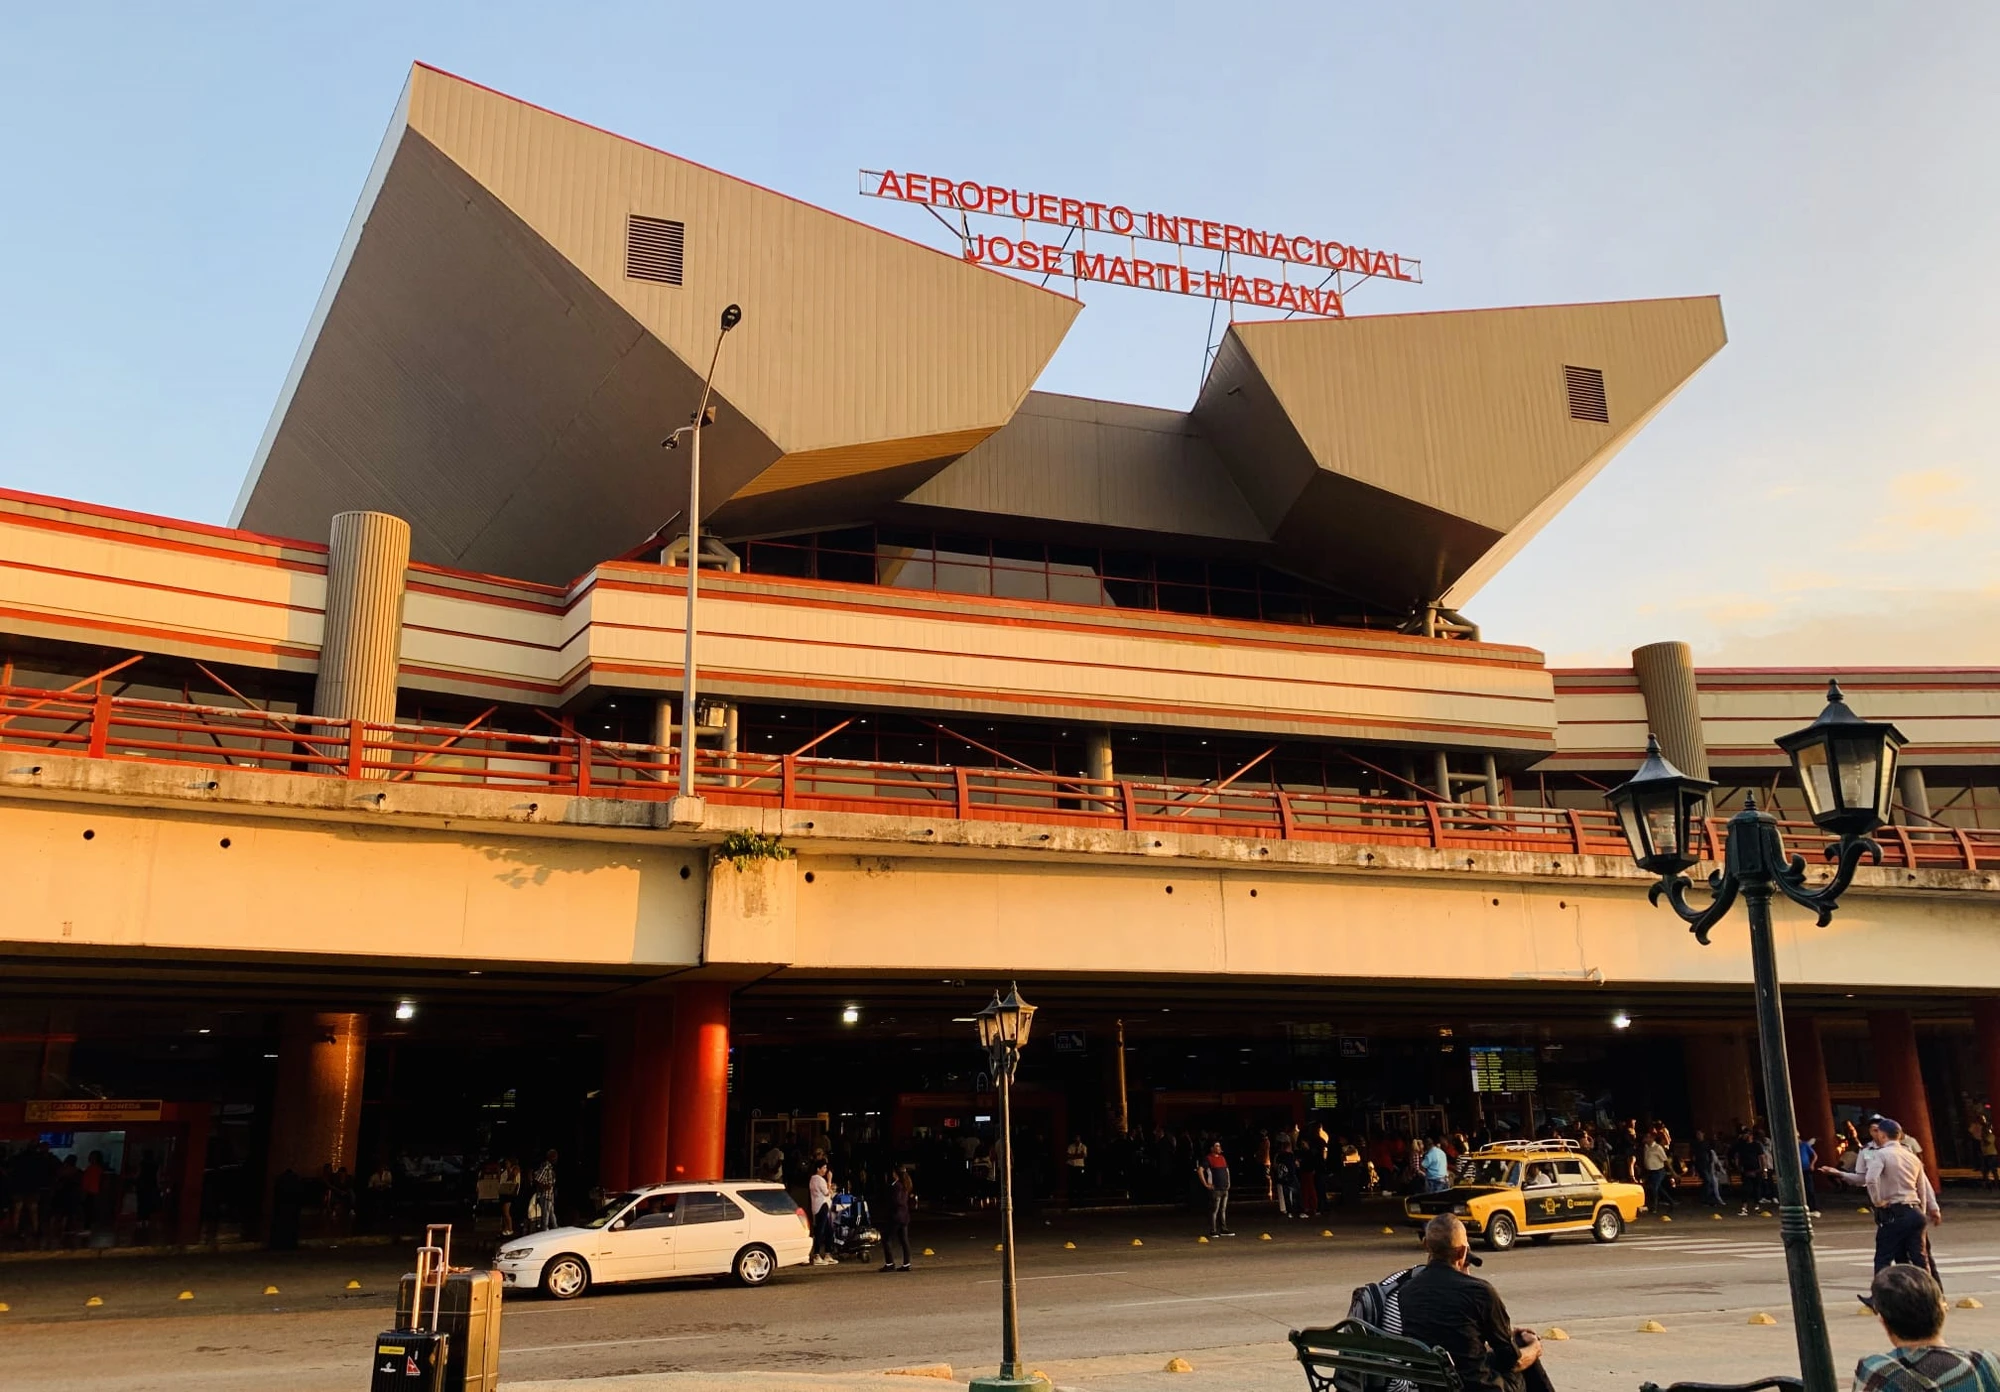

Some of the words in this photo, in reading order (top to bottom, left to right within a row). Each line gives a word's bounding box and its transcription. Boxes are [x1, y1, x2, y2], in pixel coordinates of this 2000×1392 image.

[877, 169, 1134, 234] AEROPUERTO
[1147, 211, 1412, 281] INTERNACIONAL
[966, 234, 1063, 274] JOSE
